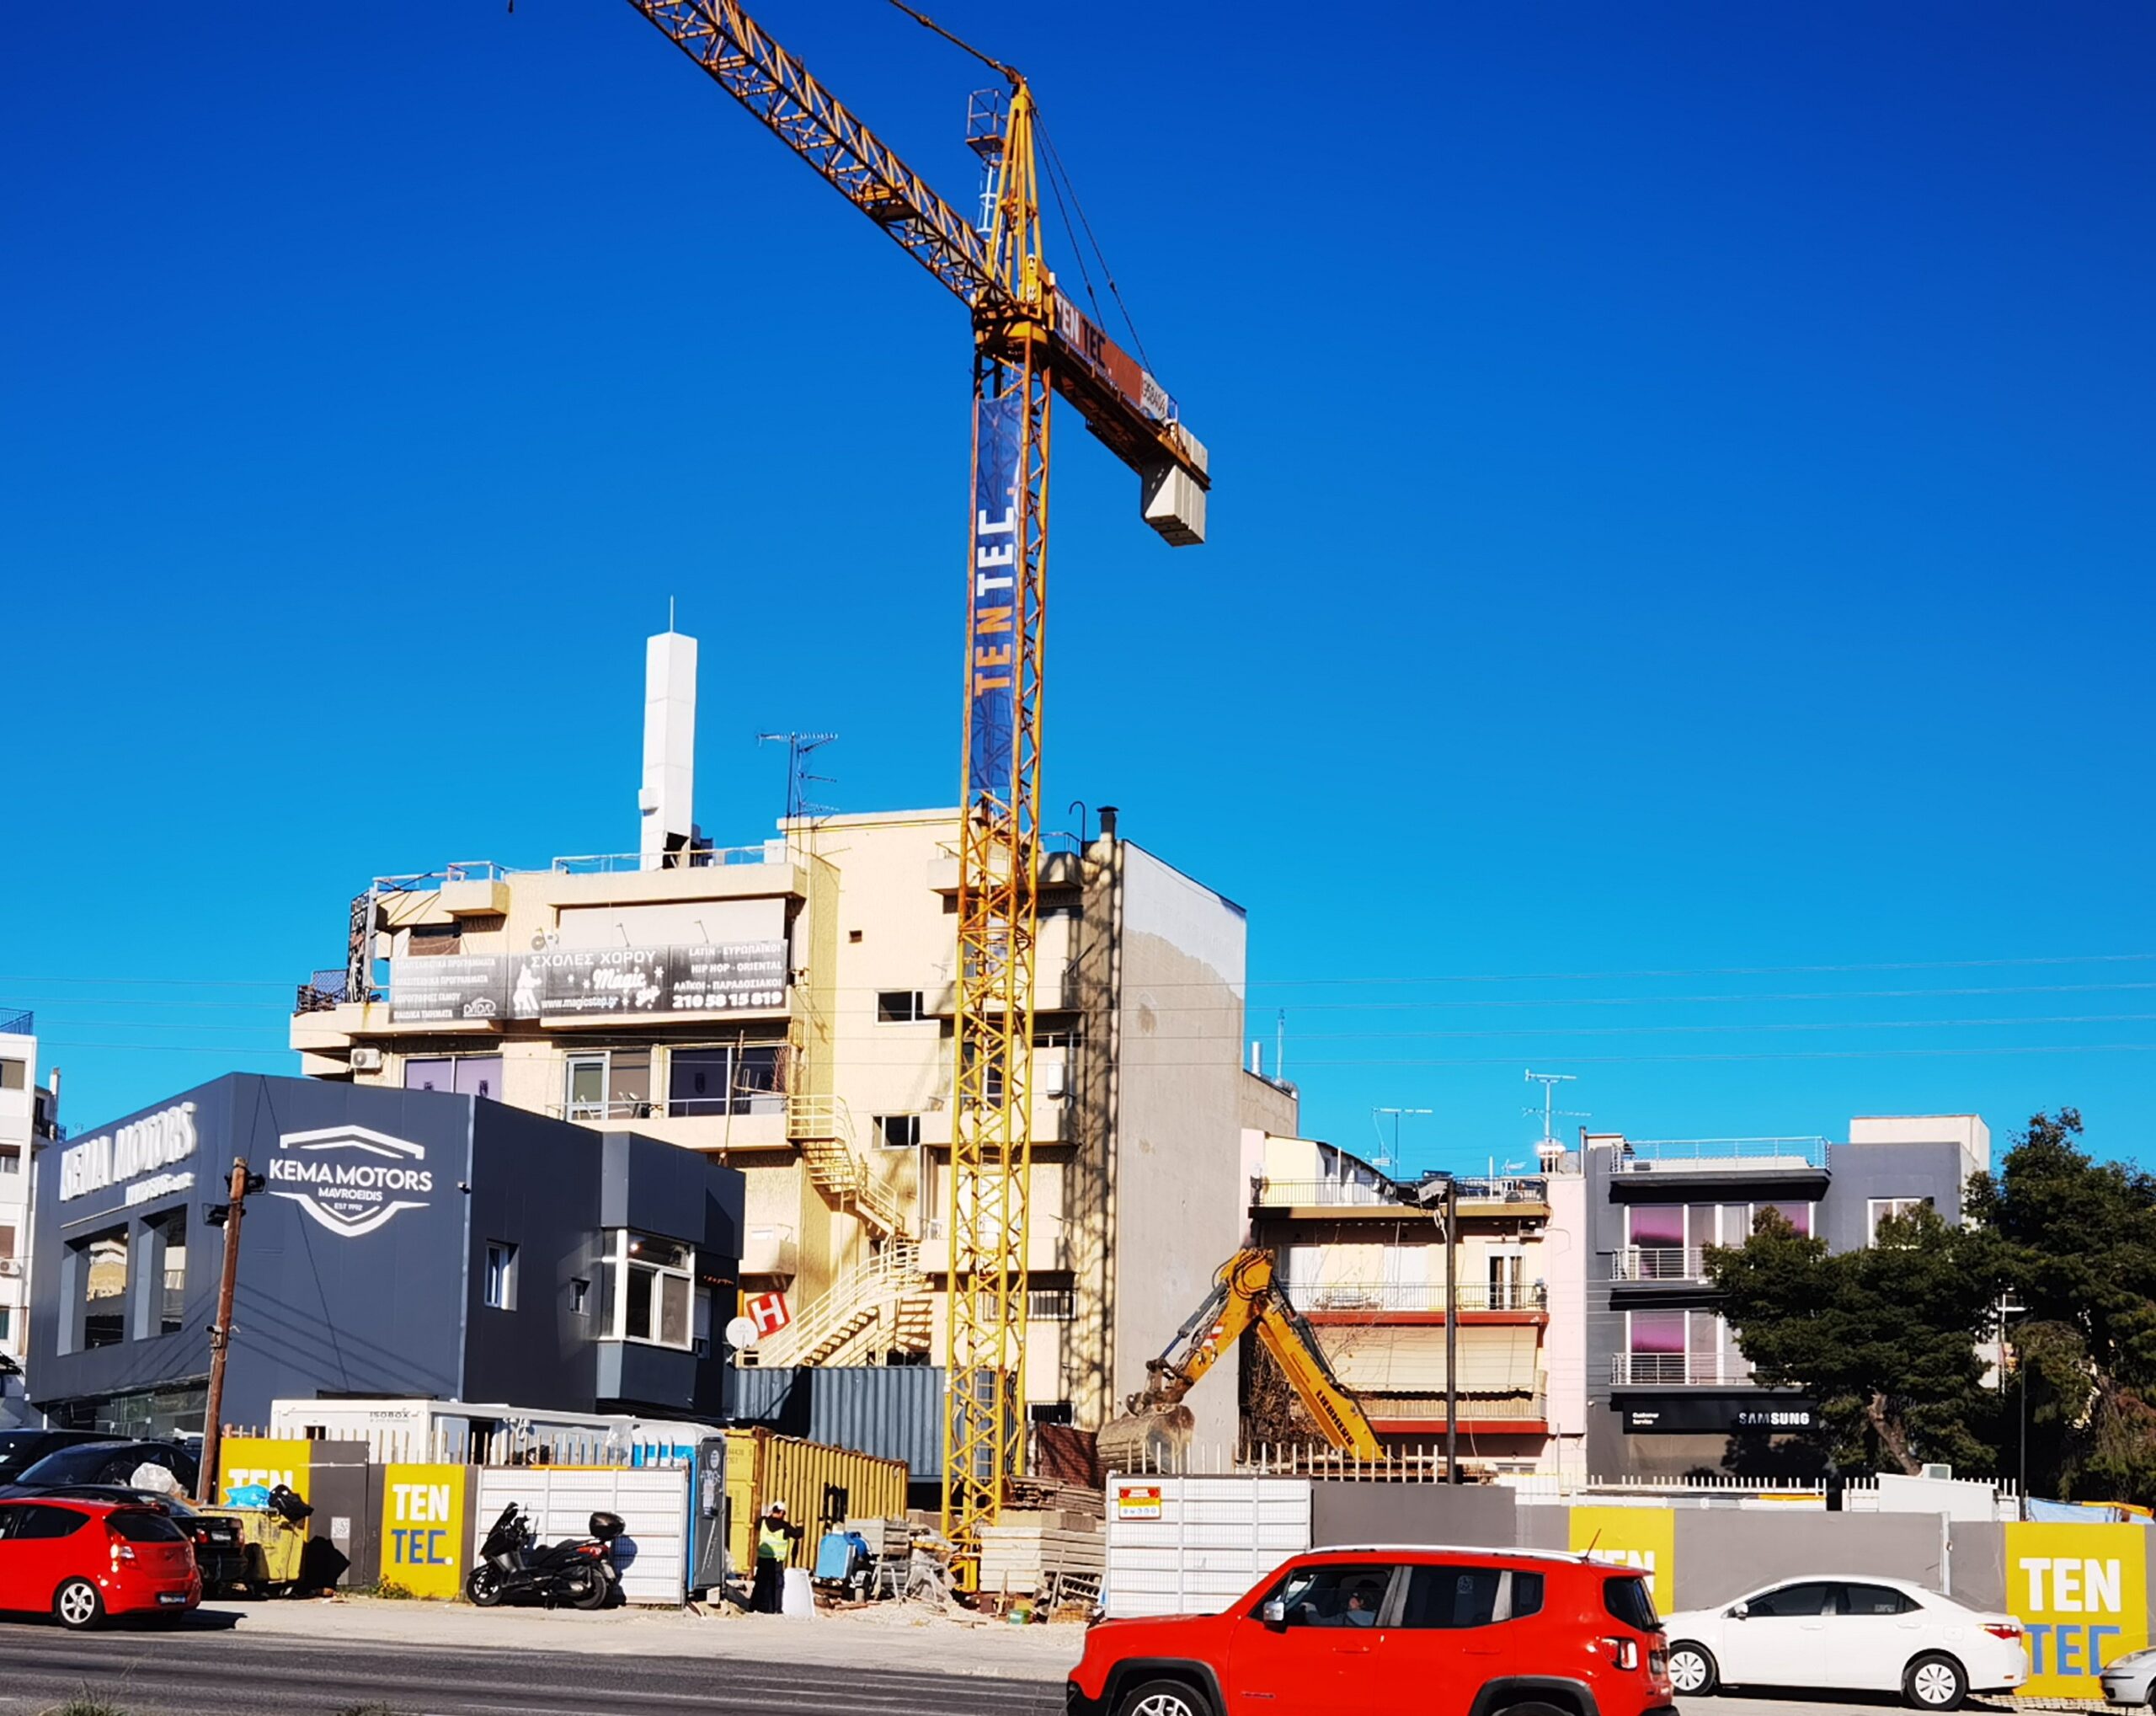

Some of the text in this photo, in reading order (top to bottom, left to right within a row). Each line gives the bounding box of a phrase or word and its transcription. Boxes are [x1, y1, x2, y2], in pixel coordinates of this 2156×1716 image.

[531, 950, 656, 968] ΣΧΟΛΕΣ ΧΟΡΟΥ
[689, 947, 716, 957] LATIN
[691, 961, 782, 974] HIP HOP ORIENTAL
[592, 966, 647, 993] Magic
[672, 992, 782, 1008] 210 58 15 819
[270, 1158, 433, 1192] KEMA MOTORS
[318, 1187, 383, 1202] MAVROEIDIS
[1739, 1412, 1810, 1425] SAMSUNG
[392, 1483, 451, 1521] TEN
[391, 1529, 453, 1565] TEC.
[2019, 1557, 2121, 1612] TEN
